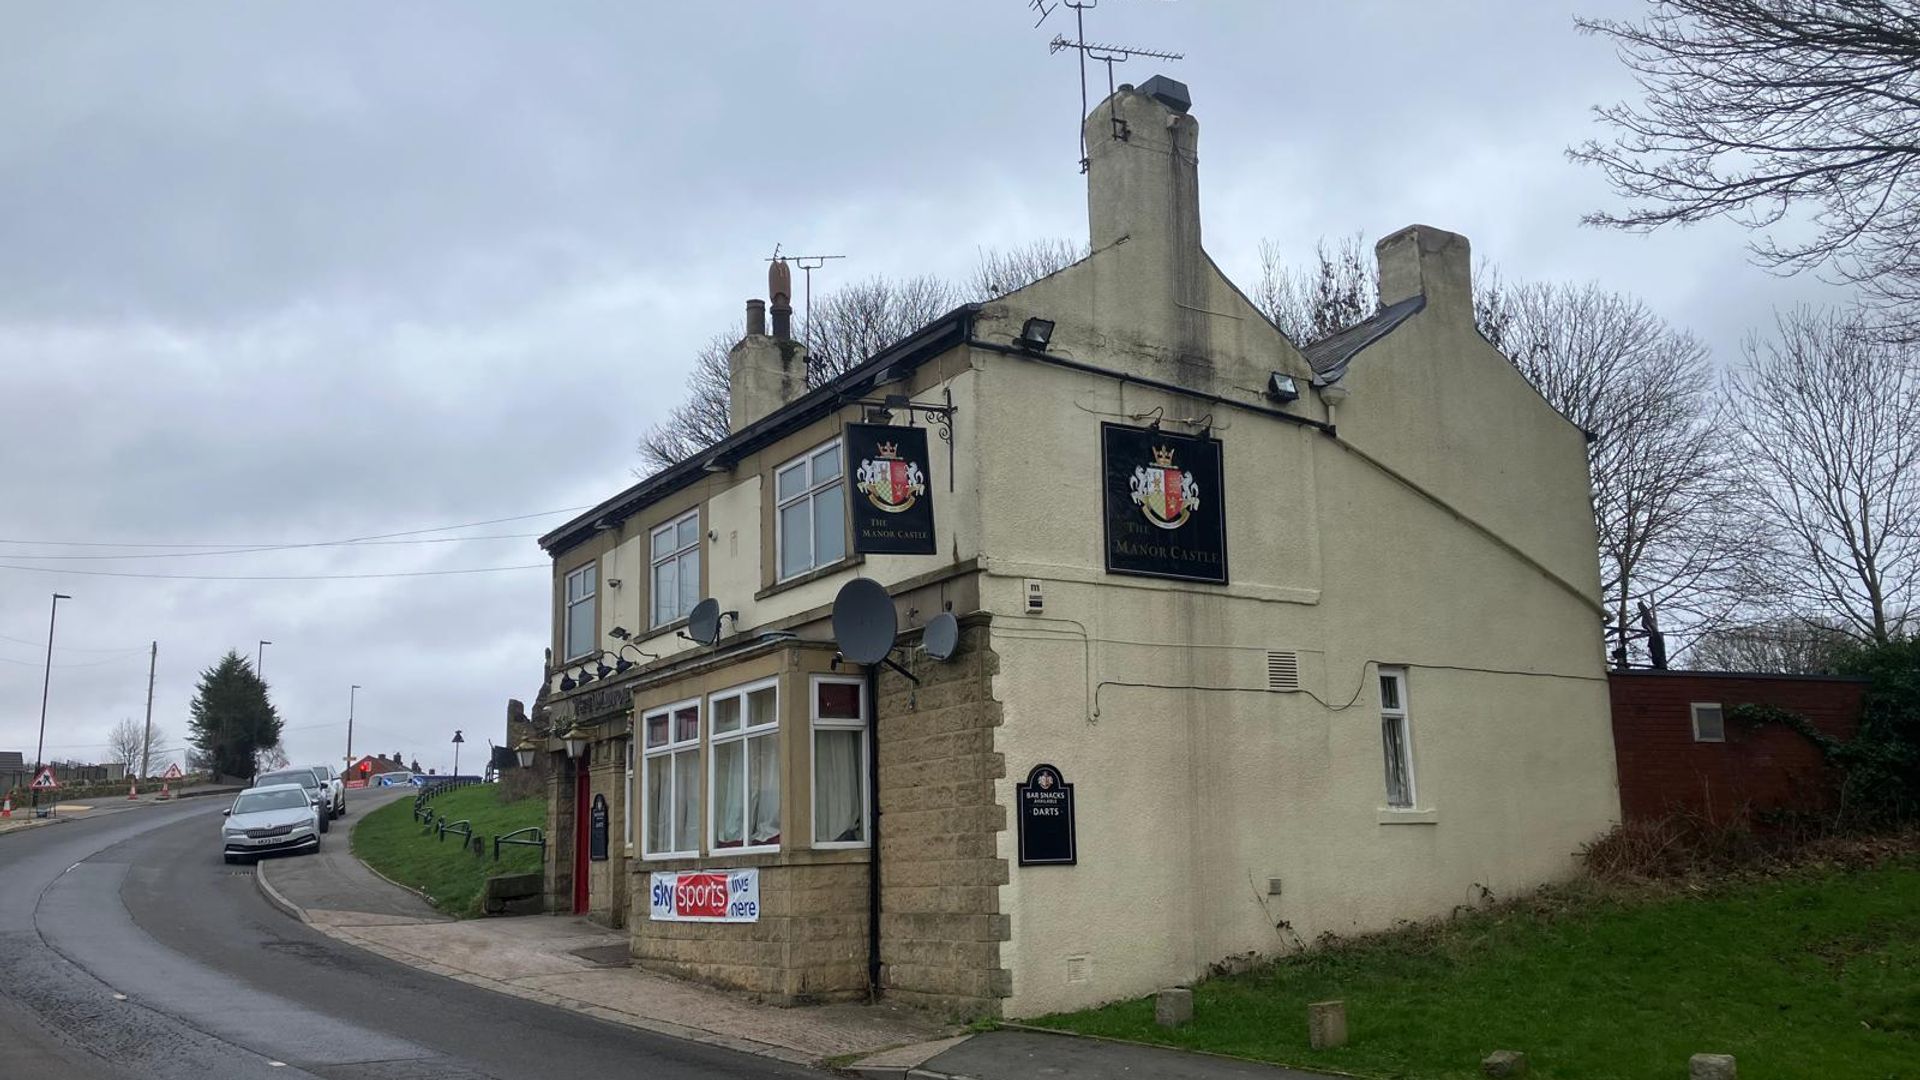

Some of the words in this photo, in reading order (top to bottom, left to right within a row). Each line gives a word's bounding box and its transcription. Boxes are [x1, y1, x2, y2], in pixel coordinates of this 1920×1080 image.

[862, 529, 896, 538] MANOR
[897, 530, 929, 540] CASTLE
[1115, 539, 1167, 559] MANOR
[1170, 546, 1218, 564] CASTLE
[1026, 791, 1039, 799] BAR
[1040, 791, 1065, 799] SNACKS
[1033, 807, 1059, 816] DARTS
[653, 880, 674, 913] sky
[678, 881, 726, 912] sports
